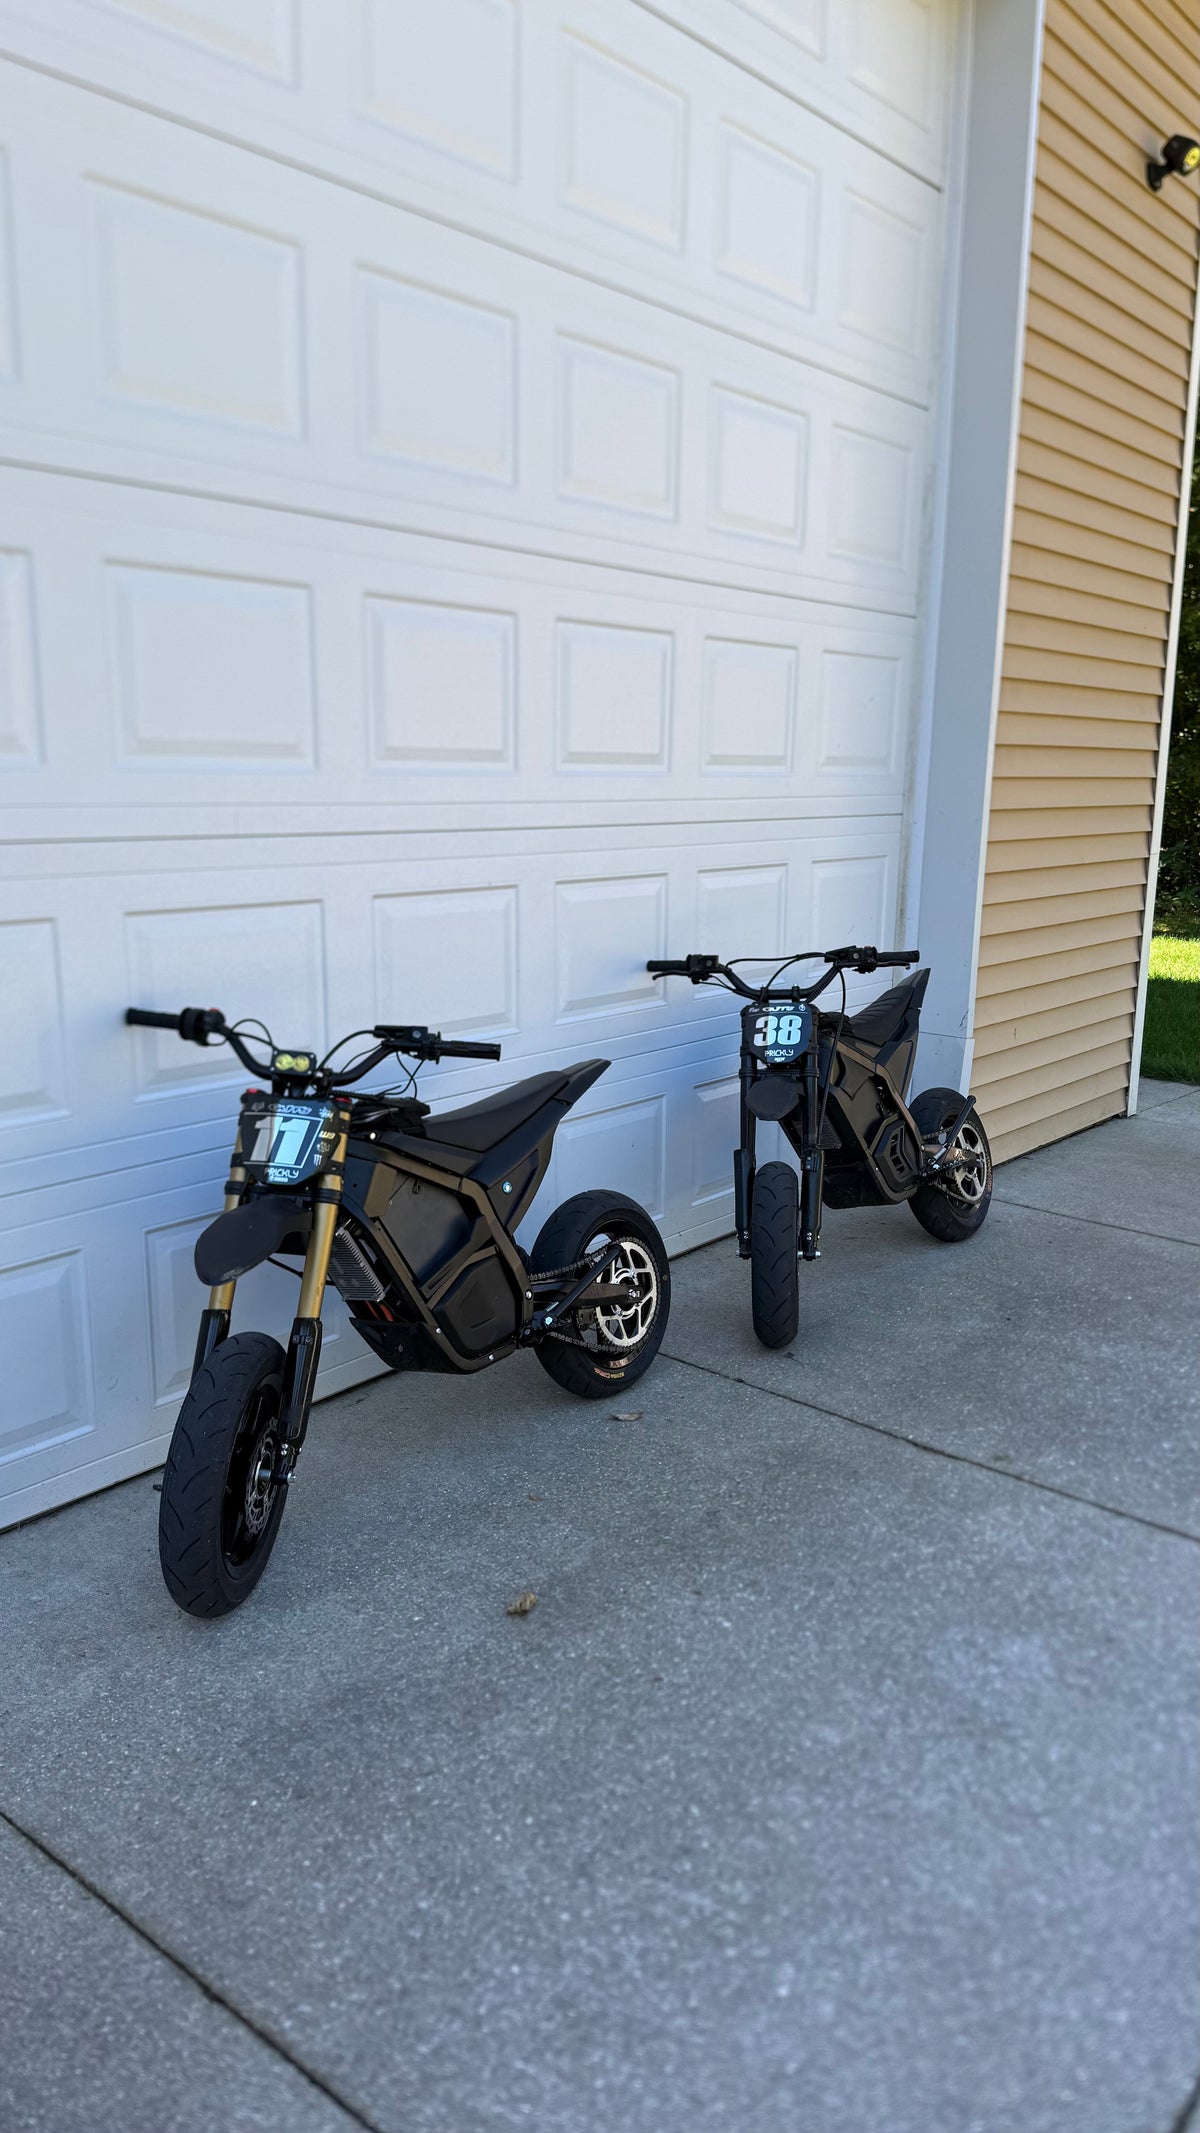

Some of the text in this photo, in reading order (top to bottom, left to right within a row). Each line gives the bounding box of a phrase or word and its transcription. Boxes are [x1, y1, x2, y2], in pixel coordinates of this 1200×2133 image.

[753, 1014, 802, 1047] 38
[764, 1049, 794, 1057] PRICKLY
[250, 1116, 310, 1165] 11
[264, 1167, 299, 1179] PRICKLY
